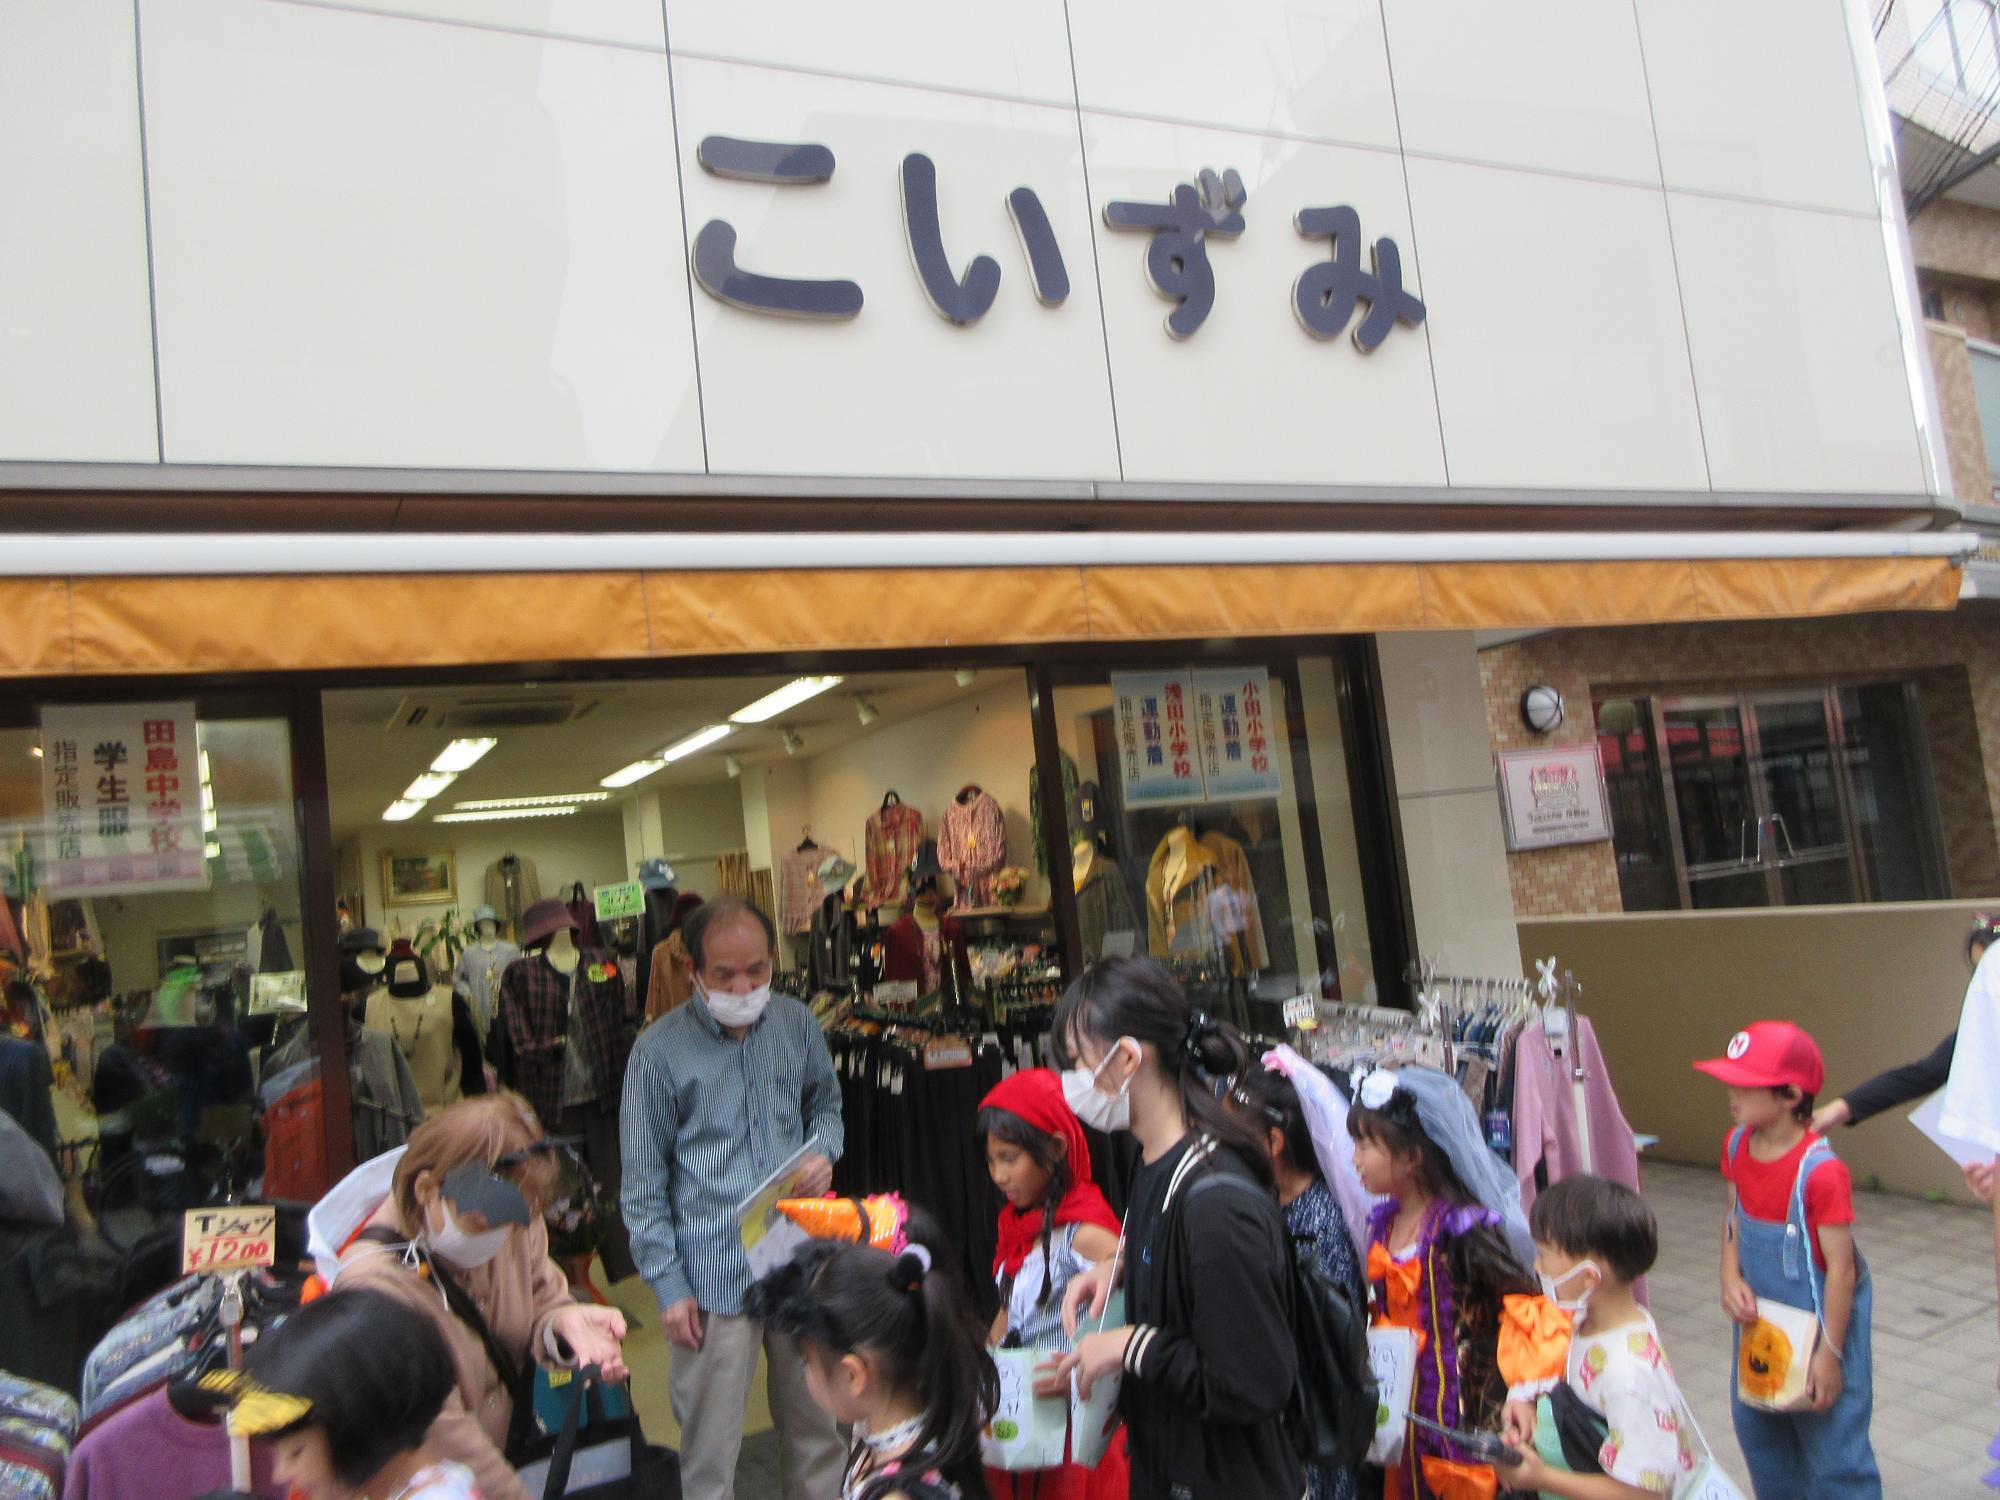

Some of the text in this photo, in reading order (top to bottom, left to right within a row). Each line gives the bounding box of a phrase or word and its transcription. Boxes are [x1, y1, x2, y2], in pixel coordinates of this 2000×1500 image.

[691, 134, 1427, 355] こいずみ
[1141, 695, 1162, 765] 運動着
[1220, 693, 1241, 761] 運動着
[1242, 680, 1269, 774] 小田小学校
[54, 740, 81, 859] 指定販売店
[93, 741, 130, 836] 学生服
[143, 719, 181, 853] 田島中学校
[188, 1238, 269, 1268] ¥1200
